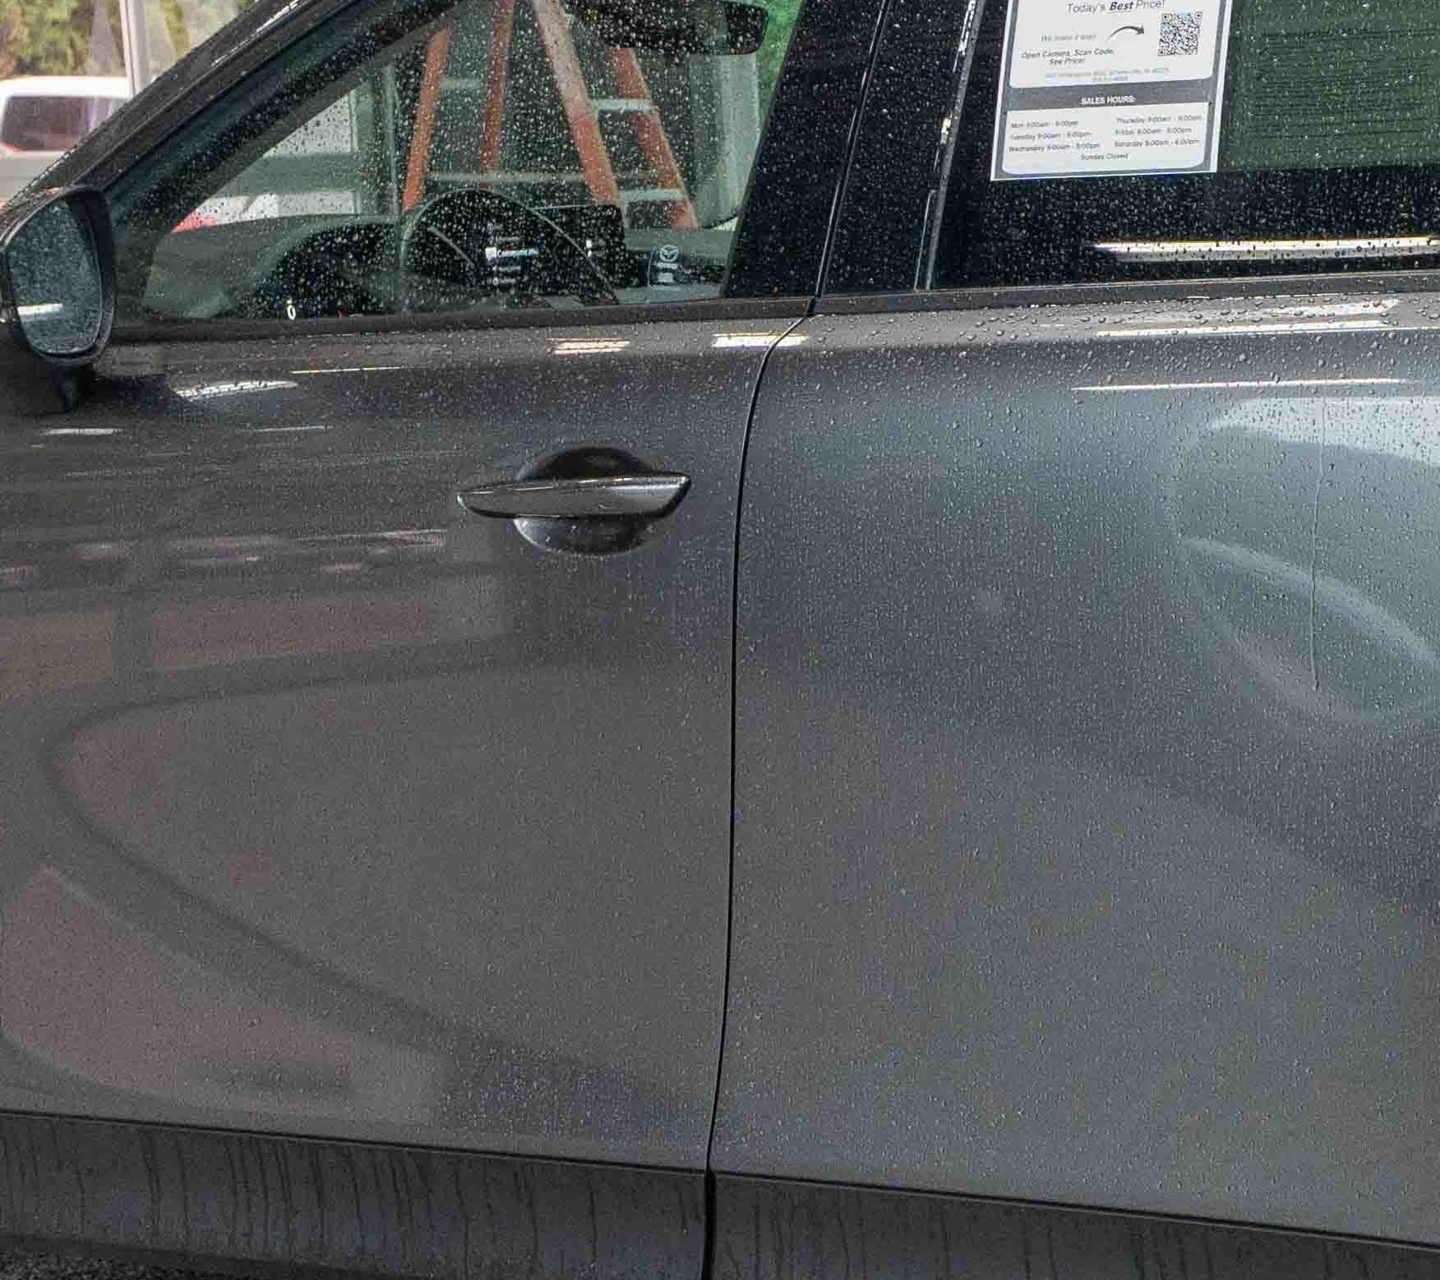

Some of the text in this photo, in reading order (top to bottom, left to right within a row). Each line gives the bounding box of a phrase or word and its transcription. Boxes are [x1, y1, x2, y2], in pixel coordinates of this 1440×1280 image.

[1068, 0, 1166, 15] Today's Best Price!
[1081, 96, 1105, 105] SALES
